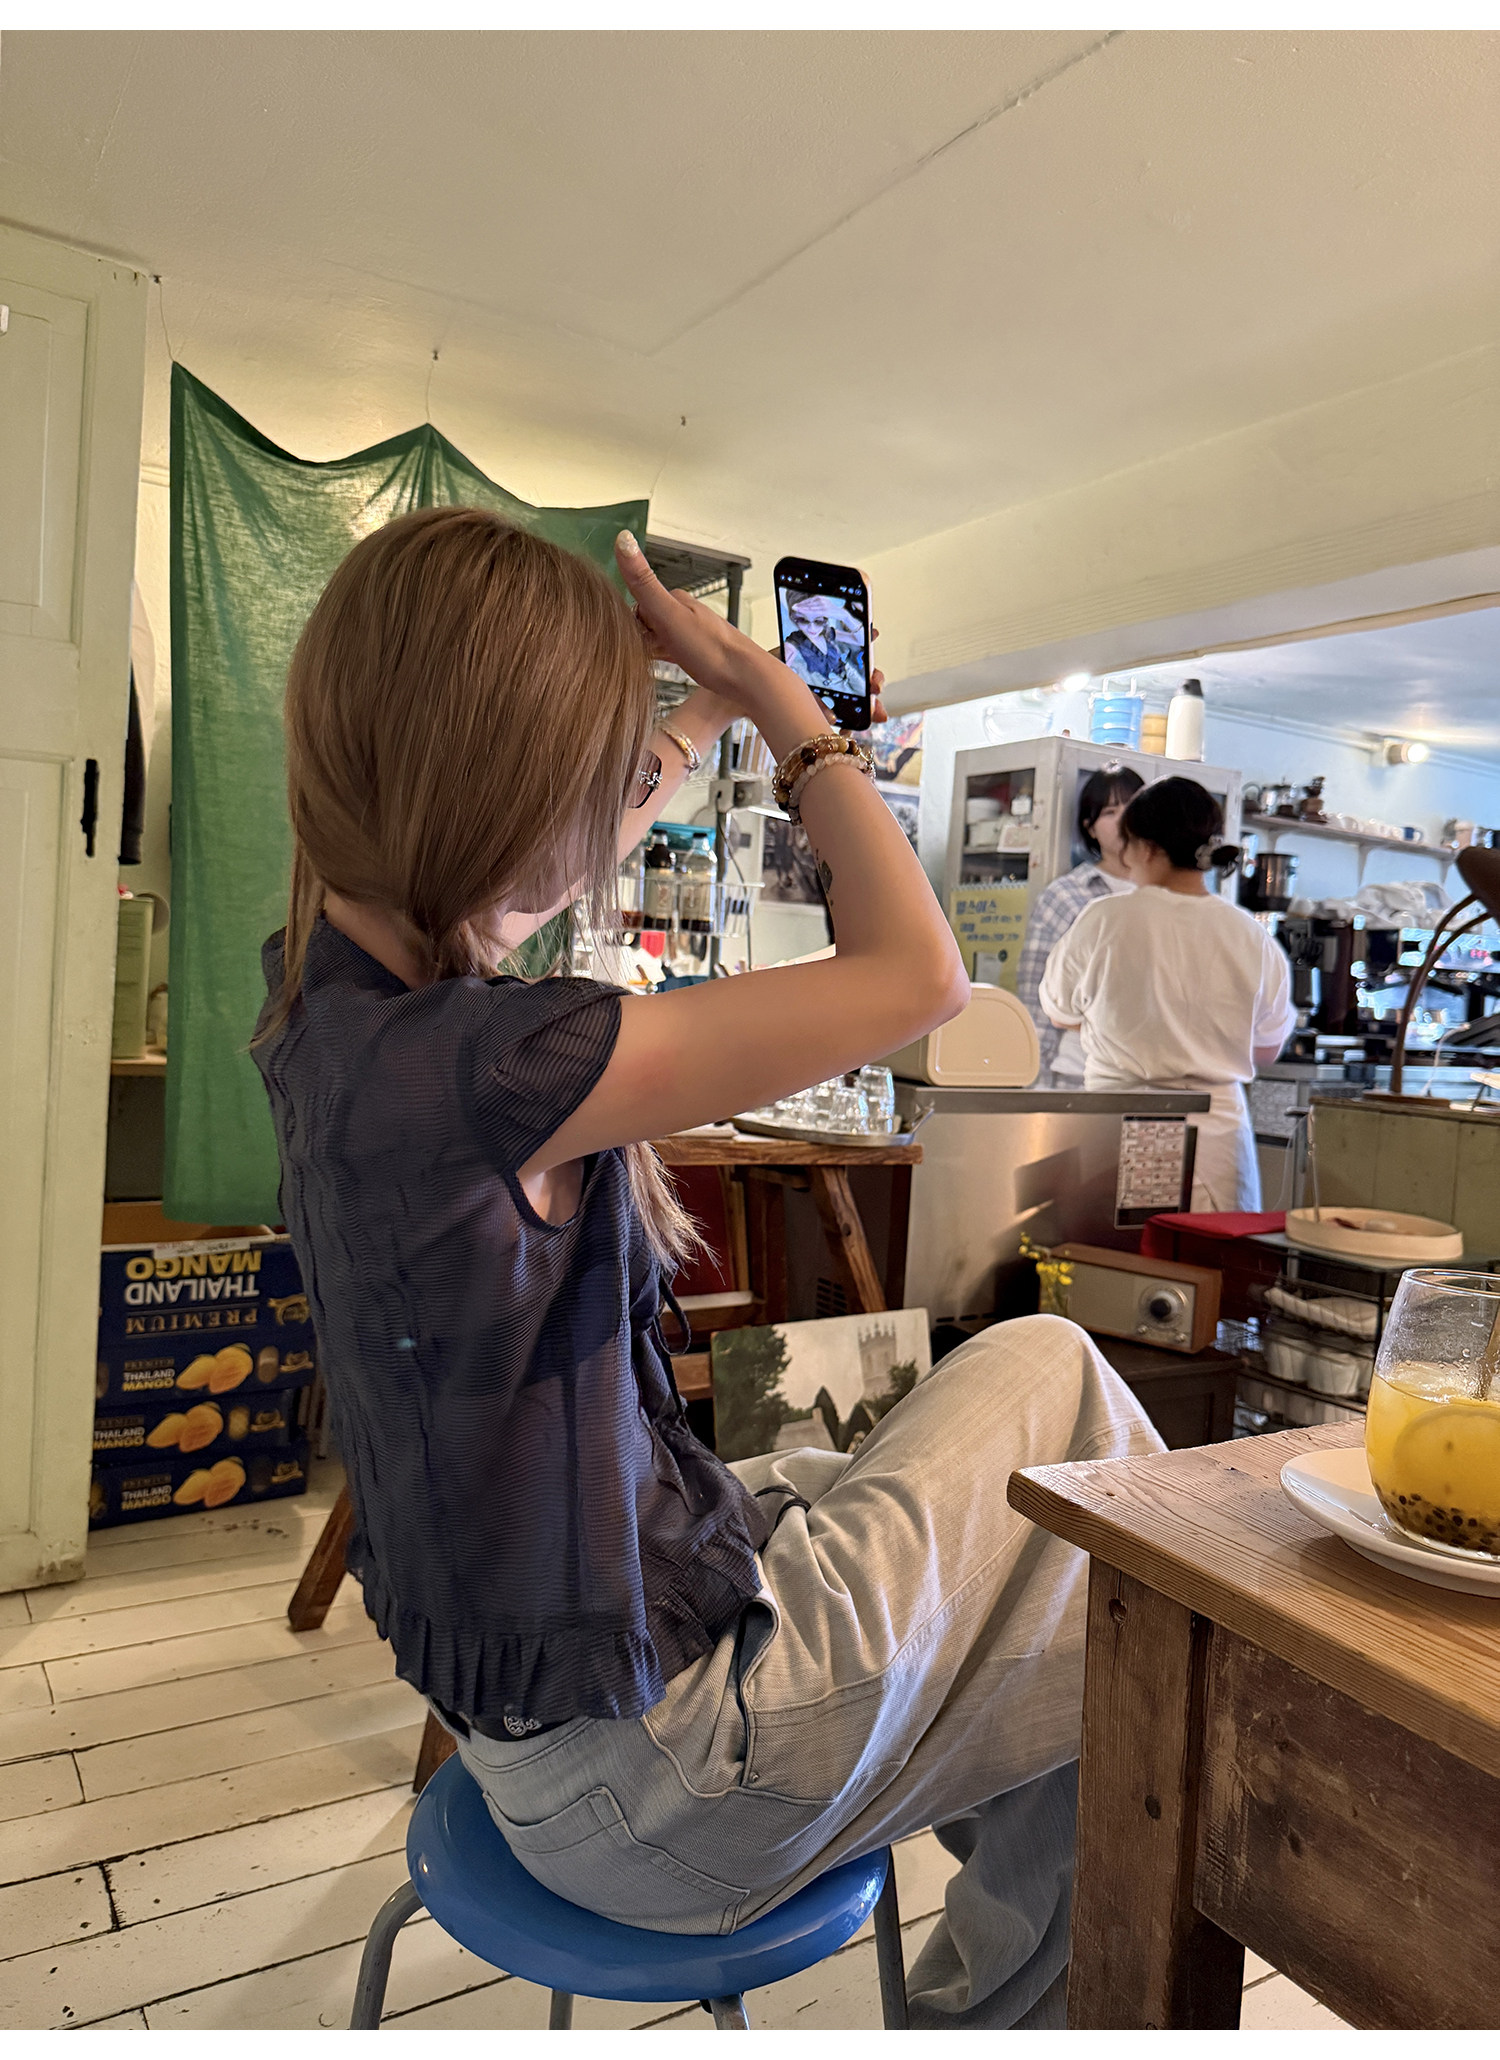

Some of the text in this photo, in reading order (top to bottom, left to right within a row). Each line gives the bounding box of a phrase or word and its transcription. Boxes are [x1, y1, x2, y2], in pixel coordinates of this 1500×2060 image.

[126, 1251, 262, 1279] MANGO
[125, 1274, 260, 1305] THAILAND
[126, 1307, 258, 1334] PREMIUM
[123, 1368, 175, 1382] THAILAND
[122, 1378, 175, 1392] MANGO
[94, 1427, 145, 1441] THAILAND
[93, 1436, 144, 1450] MANGO
[121, 1485, 172, 1500] THAILAND
[121, 1495, 171, 1511] MANGO
